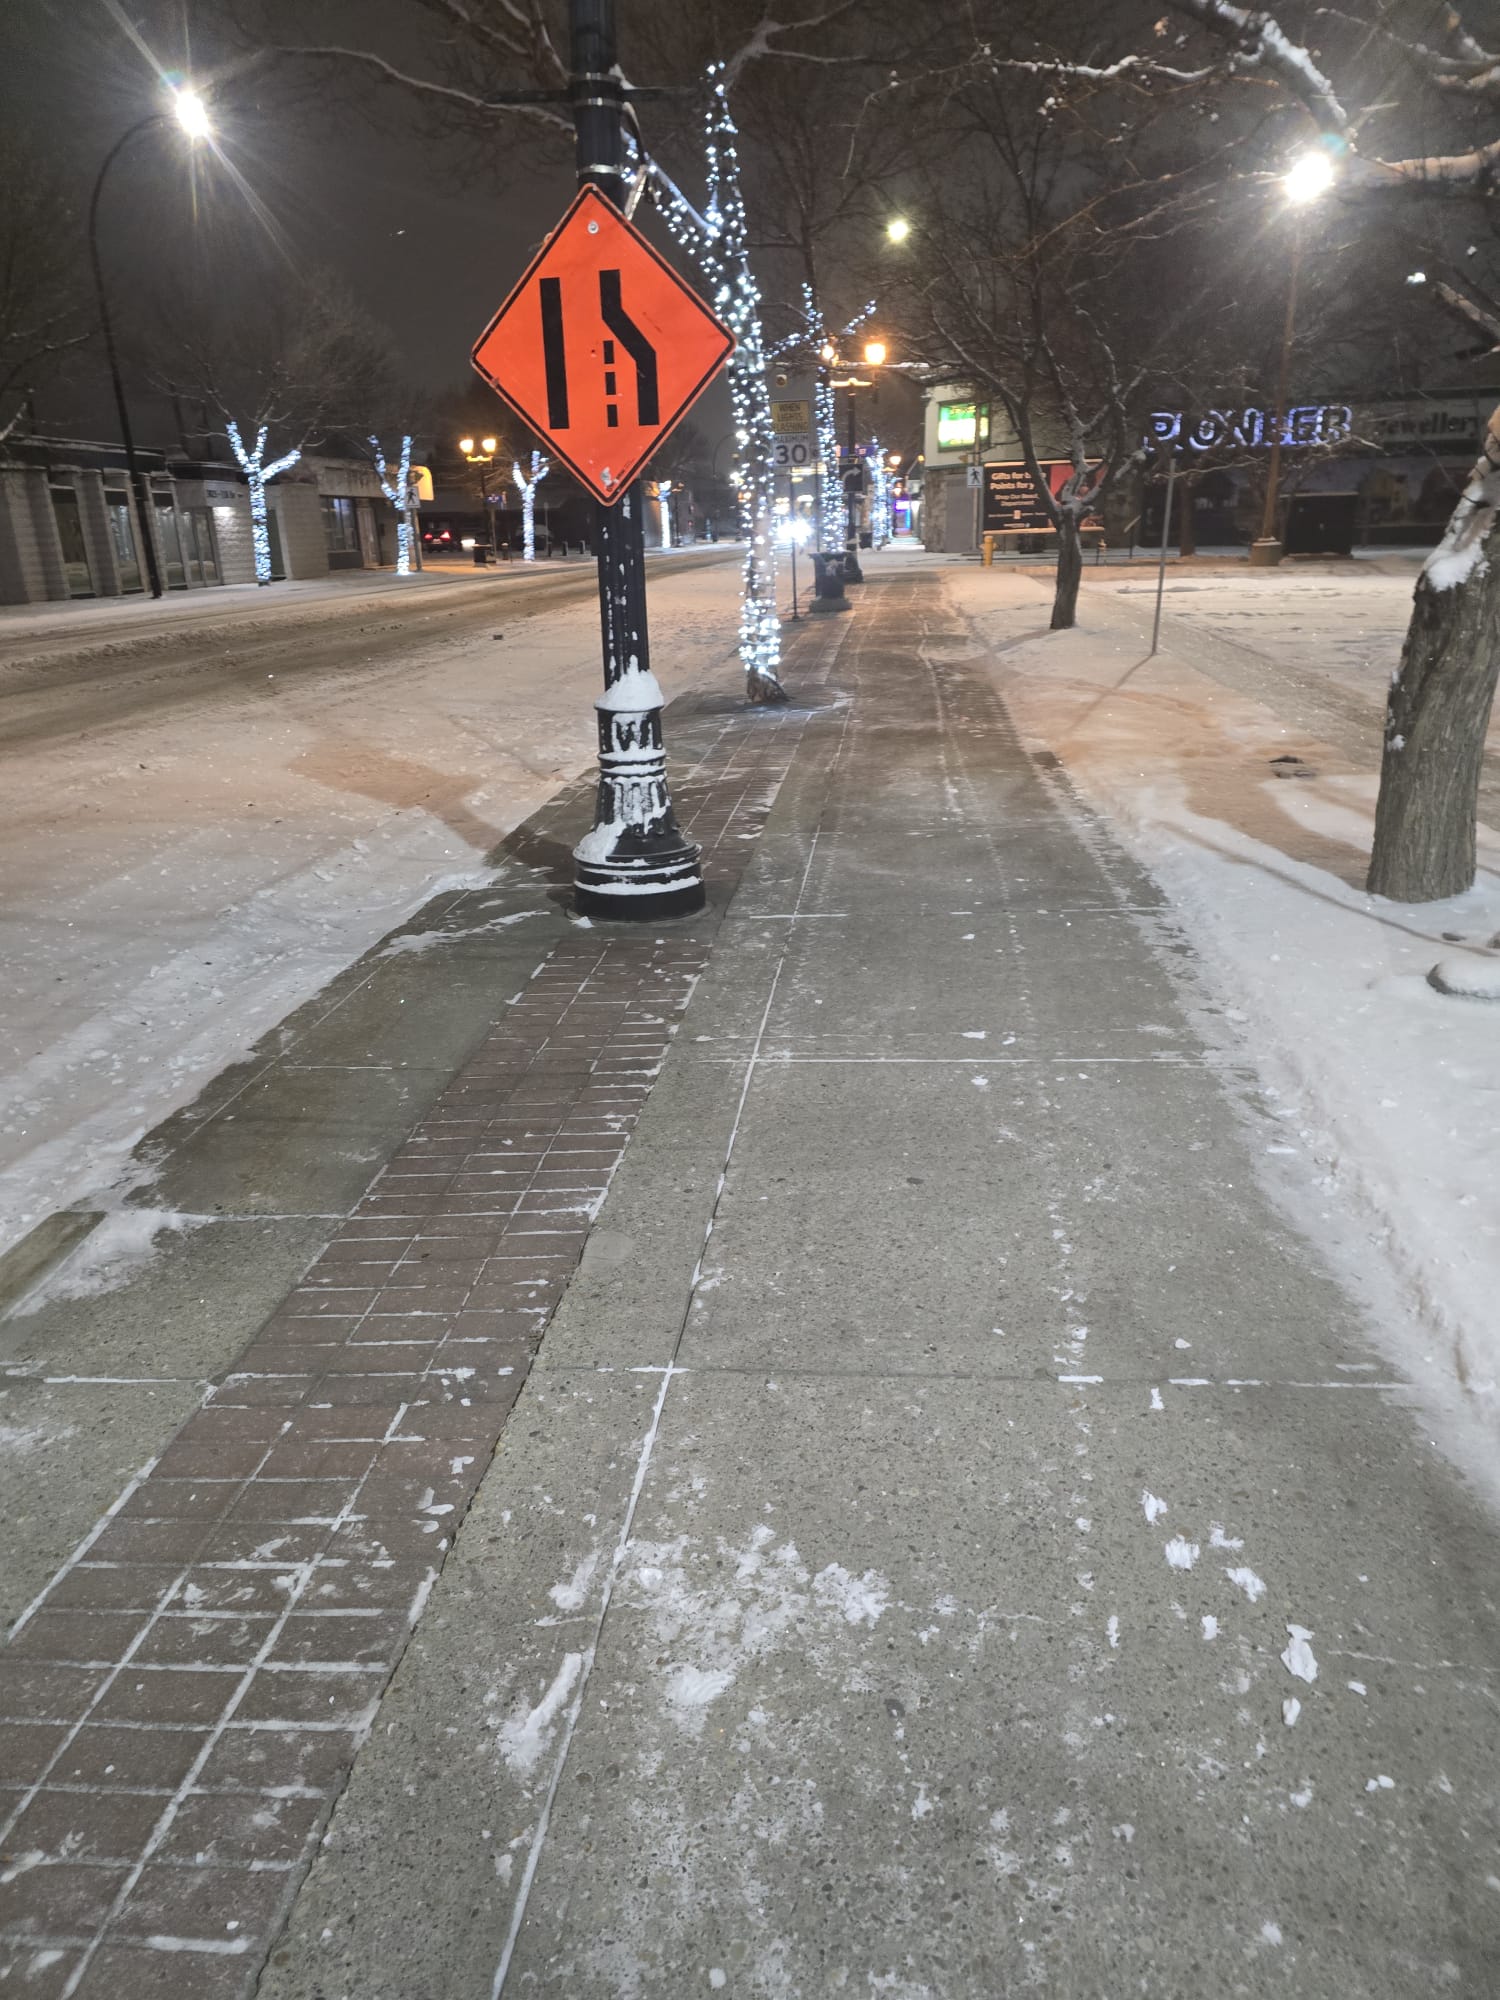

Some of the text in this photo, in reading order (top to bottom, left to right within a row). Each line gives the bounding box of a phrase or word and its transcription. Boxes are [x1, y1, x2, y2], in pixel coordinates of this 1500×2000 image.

[779, 403, 801, 412] WHEN
[1143, 405, 1353, 451] PIONEER
[776, 444, 806, 464] 30
[1016, 482, 1029, 490] for
